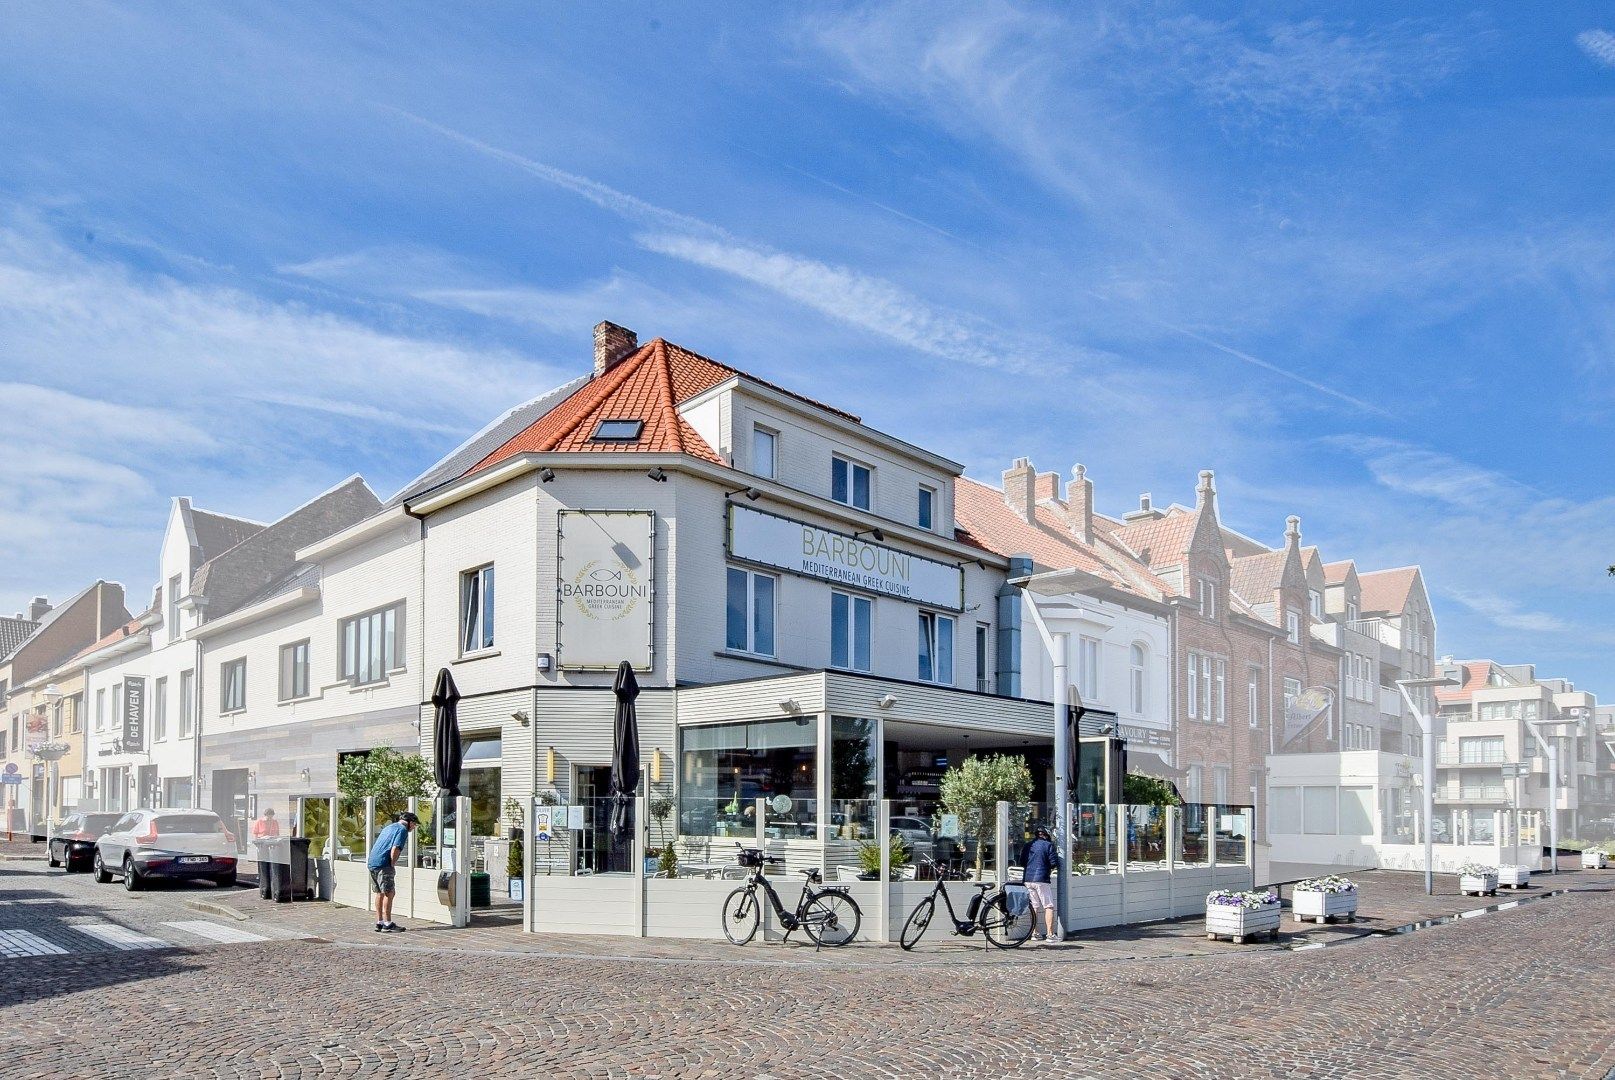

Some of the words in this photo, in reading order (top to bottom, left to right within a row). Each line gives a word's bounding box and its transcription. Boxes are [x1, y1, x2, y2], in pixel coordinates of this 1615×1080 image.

[802, 528, 910, 582] BARBOUNI
[563, 584, 646, 597] BARBOUNI
[802, 560, 861, 583] MEDITERRANEAN
[863, 575, 884, 590] GREEK
[885, 581, 910, 596] CUISINE
[129, 690, 140, 725] HAVEN
[130, 725, 139, 738] DE
